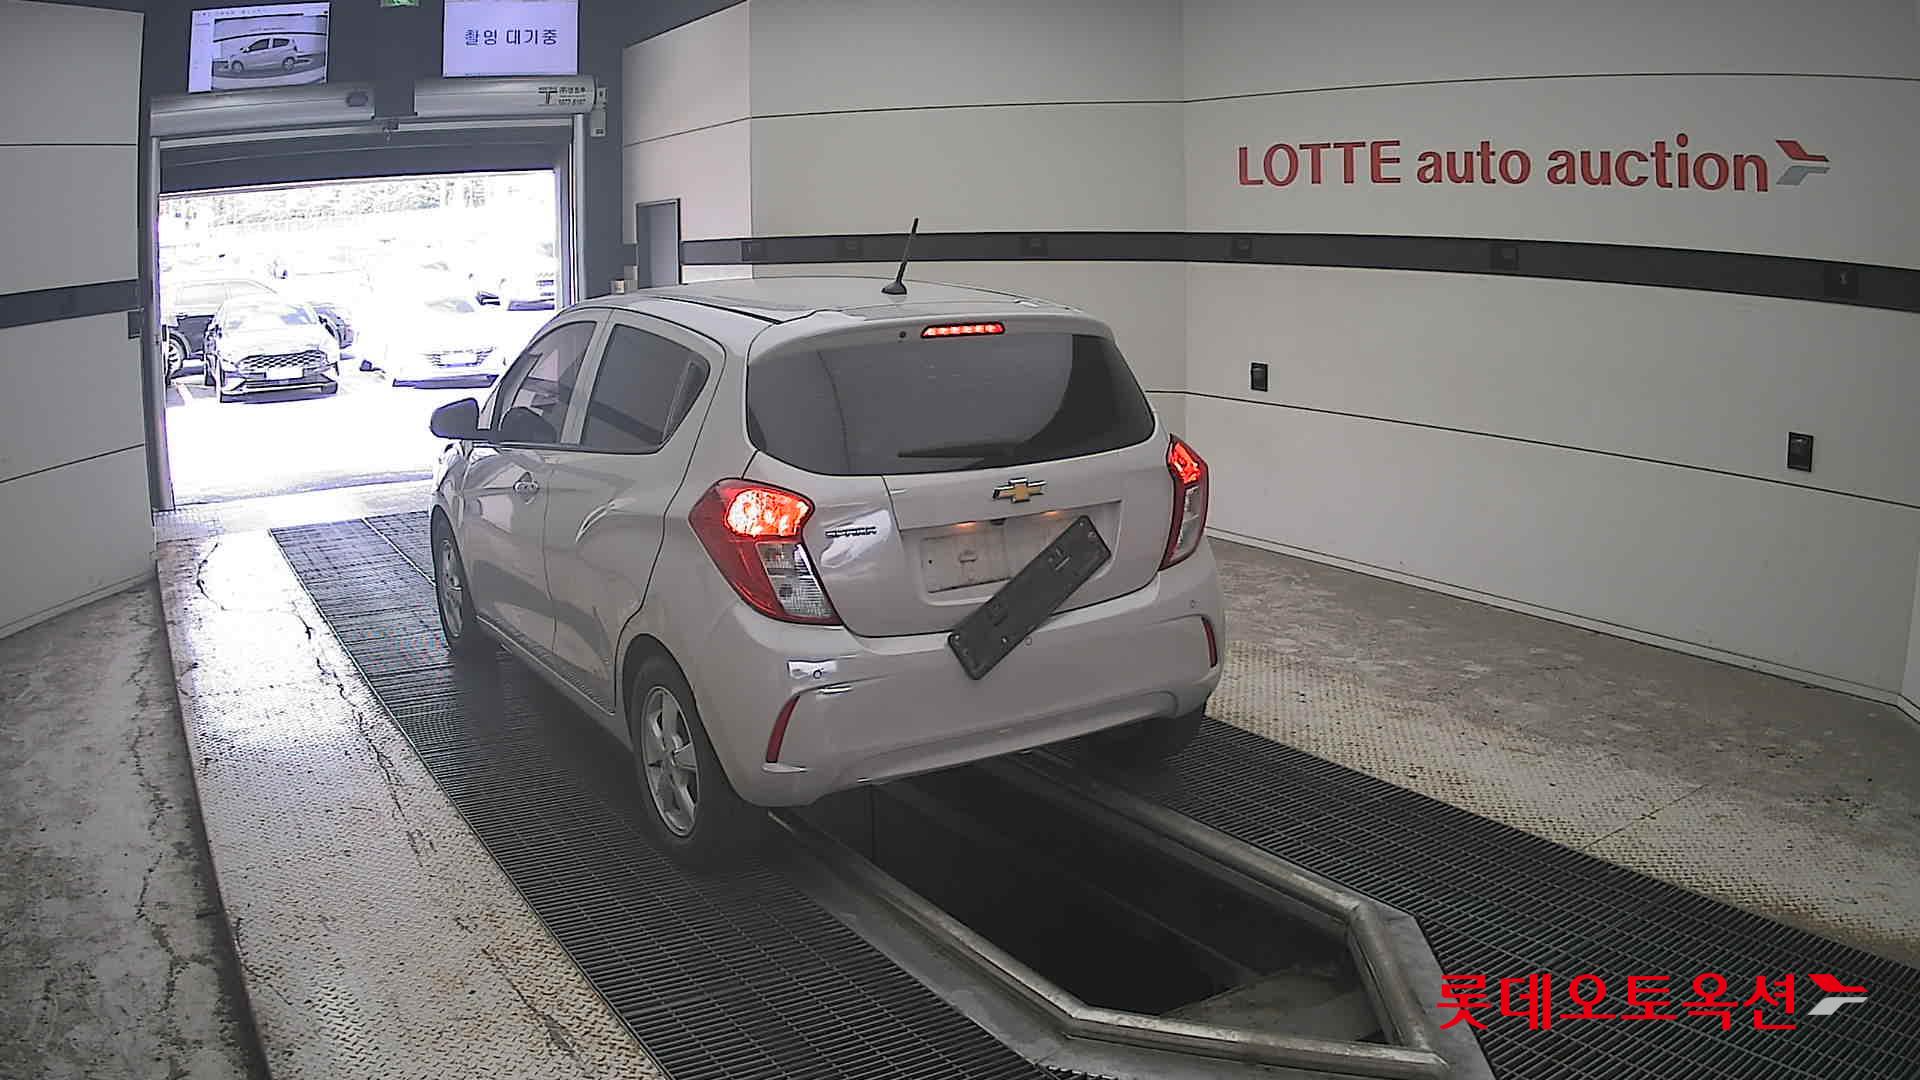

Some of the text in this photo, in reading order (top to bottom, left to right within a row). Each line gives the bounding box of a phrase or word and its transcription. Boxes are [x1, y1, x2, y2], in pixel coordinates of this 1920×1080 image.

[506, 28, 558, 45] 대기중
[1238, 133, 1769, 192] LOTTE auto auction
